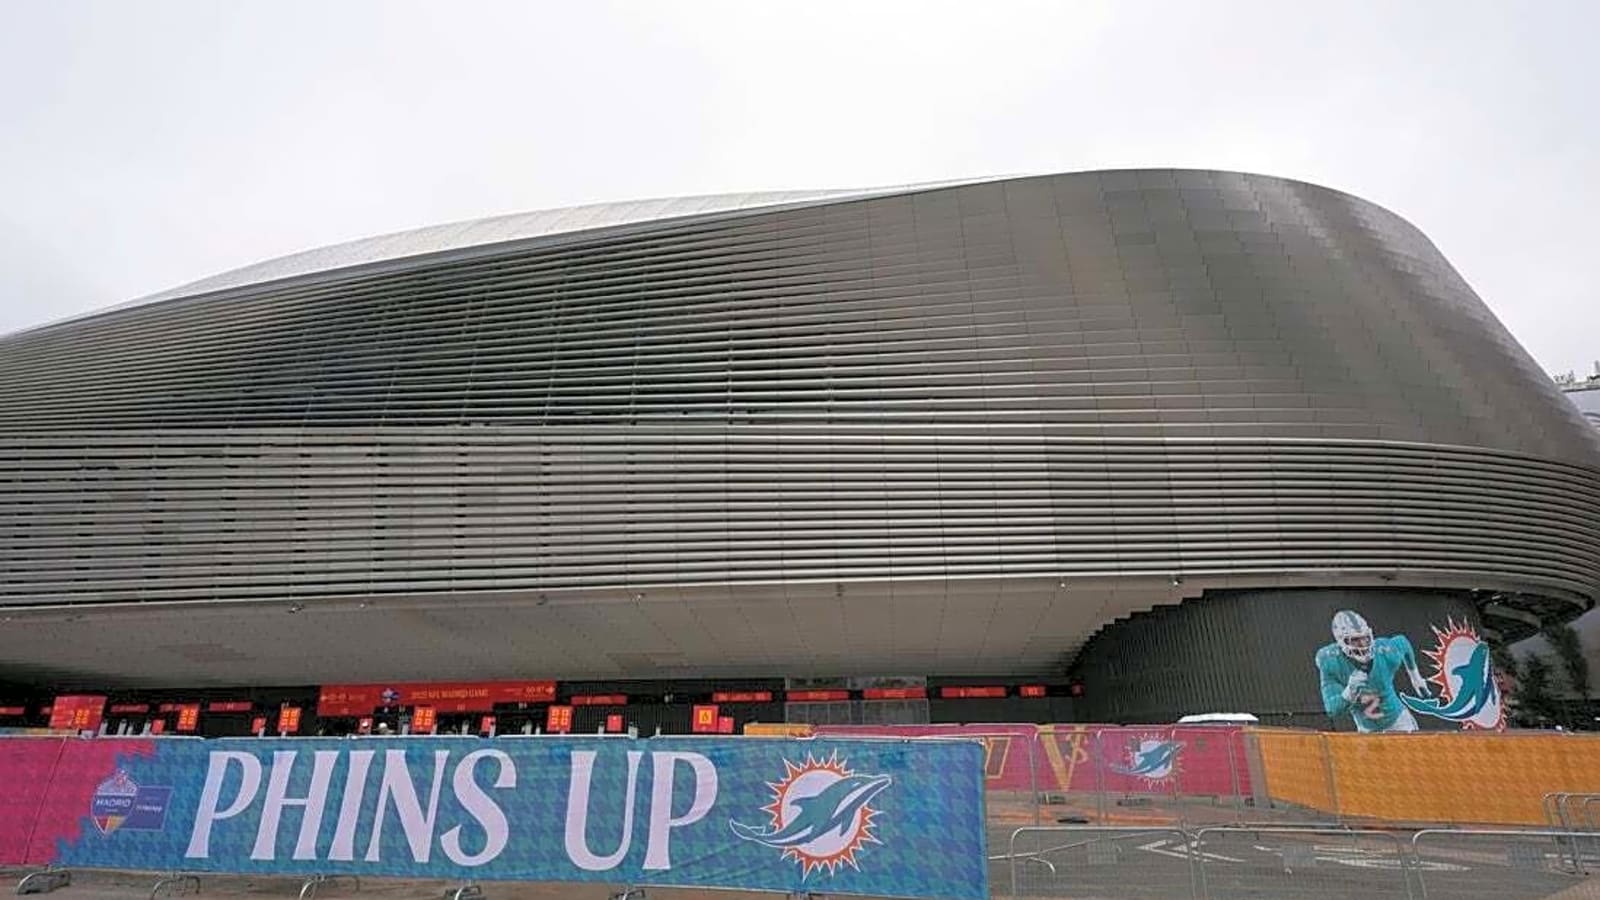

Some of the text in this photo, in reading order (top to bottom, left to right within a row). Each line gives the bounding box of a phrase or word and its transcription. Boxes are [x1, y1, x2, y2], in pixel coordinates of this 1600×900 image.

[1362, 695, 1384, 719] 2
[96, 798, 131, 808] MADRID
[185, 750, 719, 871] PHINS UP
